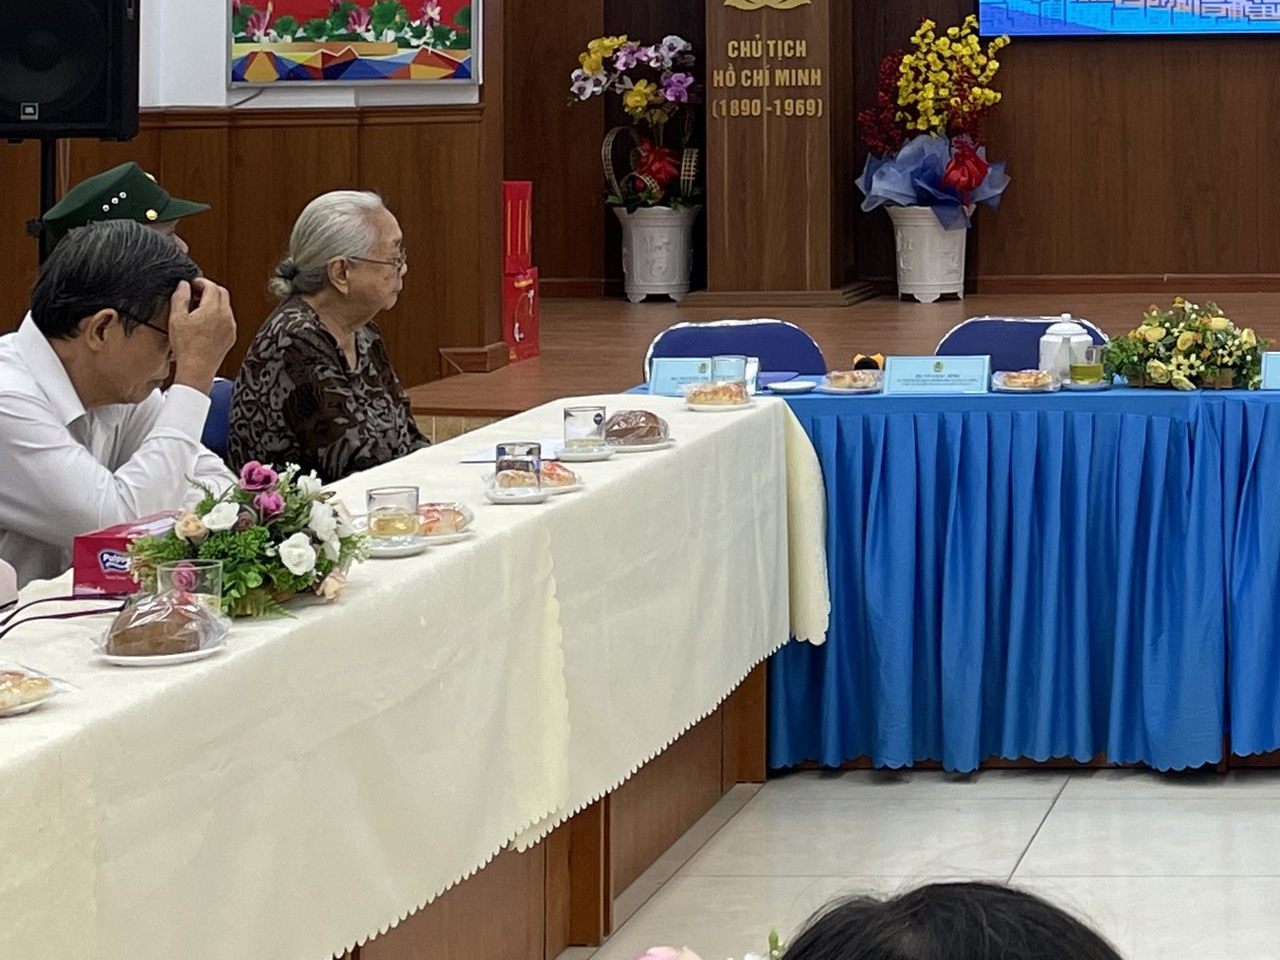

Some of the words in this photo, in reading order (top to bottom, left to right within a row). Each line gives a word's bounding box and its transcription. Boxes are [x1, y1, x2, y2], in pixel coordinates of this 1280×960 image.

[727, 33, 762, 58] CHỦ
[767, 40, 807, 61] TỊCH
[713, 62, 736, 87] HỒ
[741, 65, 770, 87] CHÍ
[775, 68, 822, 87] MINH
